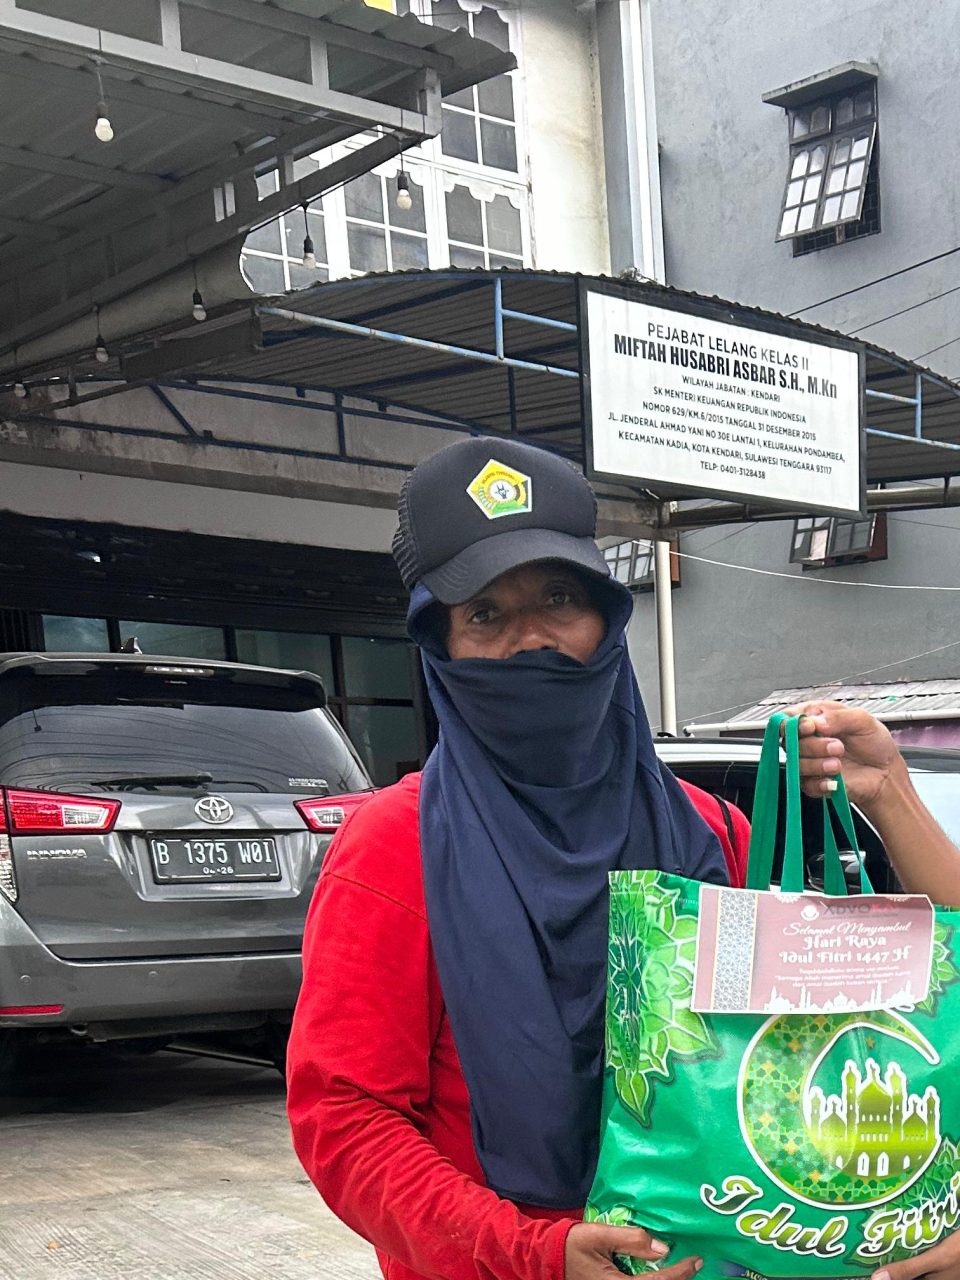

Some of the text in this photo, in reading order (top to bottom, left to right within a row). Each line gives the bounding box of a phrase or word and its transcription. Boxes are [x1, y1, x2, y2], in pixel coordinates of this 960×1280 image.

[614, 333, 666, 363] MIFTAH
[670, 345, 729, 376] HUSABRI
[732, 359, 775, 385] ASBAR
[807, 375, 836, 398] M.Kn
[647, 322, 809, 371] PEJABAT LELANG KELAS II
[653, 385, 806, 423] SK MENTERI KEUANGAN REPUBLIK INDONESIA
[681, 375, 713, 388] WILAYAH
[715, 383, 745, 395] JABATAN
[751, 390, 780, 402] KENDARI
[608, 412, 618, 420] JL.
[620, 414, 658, 428] JENDERAL
[659, 421, 686, 432] AHMAD
[687, 426, 704, 435] YANI
[705, 429, 716, 438] NO
[717, 431, 730, 441] 30E
[731, 434, 755, 445] LANTAI
[762, 440, 802, 453] KELURAHAN
[803, 446, 845, 462] PONDAMBEA,
[642, 402, 670, 413] NOMOR
[724, 416, 756, 430] TANGGAL
[765, 424, 800, 437] DESEMBER
[801, 430, 816, 440] 2015
[618, 430, 664, 445] KECAMATAN
[666, 438, 690, 451] KADIA,
[692, 443, 710, 453] KOTA
[711, 447, 743, 459] KENDARI,
[744, 452, 778, 464] SULAWESI
[779, 458, 814, 471] TENGGARA
[156, 842, 170, 864] B
[184, 842, 228, 864] 1375
[782, 921, 836, 936] Selamat
[802, 934, 887, 950] Hari Raya
[779, 945, 912, 965] Idul Fitri 1447 H
[700, 1175, 848, 1258] Idul
